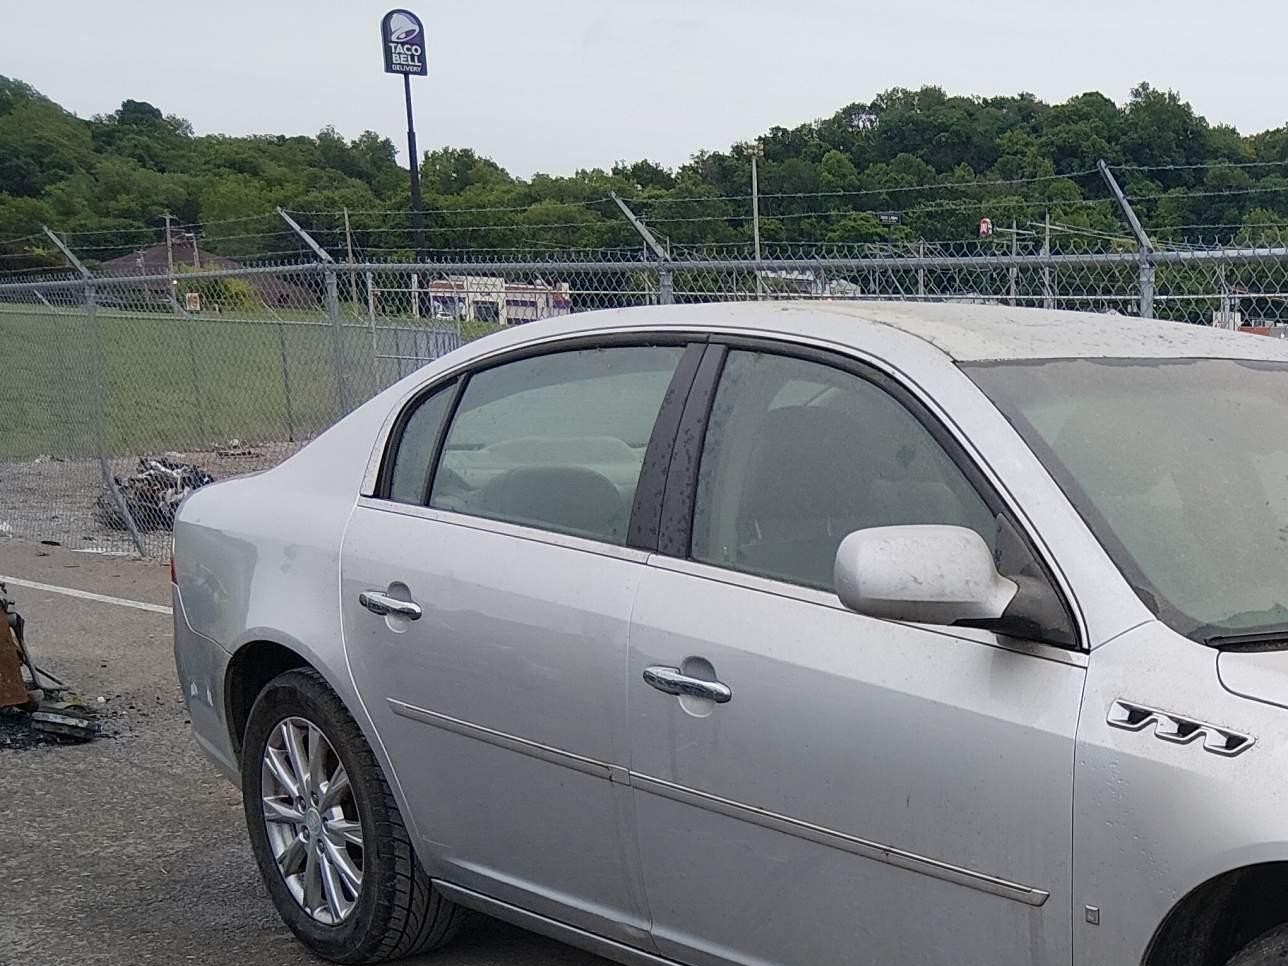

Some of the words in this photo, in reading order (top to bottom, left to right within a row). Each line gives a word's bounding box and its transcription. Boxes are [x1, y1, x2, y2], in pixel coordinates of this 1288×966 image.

[388, 42, 422, 56] TACO
[391, 53, 422, 66] BELL
[391, 64, 422, 72] DELIVERY
